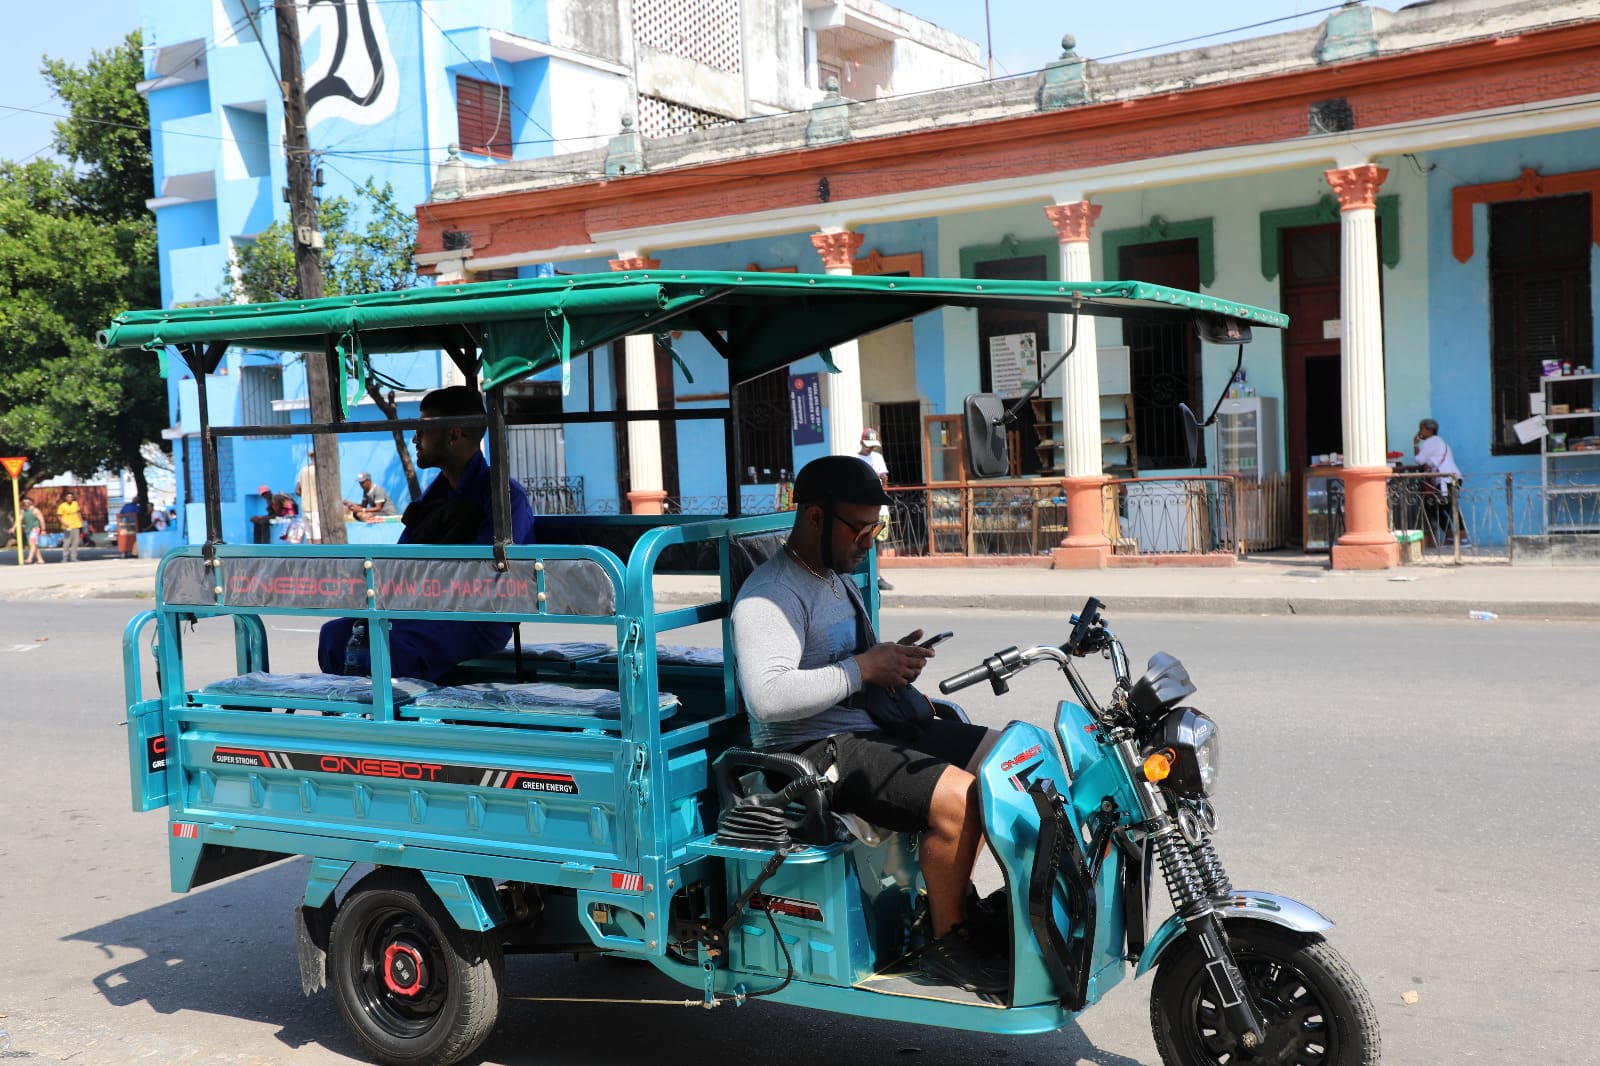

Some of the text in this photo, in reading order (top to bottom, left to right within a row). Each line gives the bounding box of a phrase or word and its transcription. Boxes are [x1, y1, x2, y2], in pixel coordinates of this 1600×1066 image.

[229, 575, 364, 596] ONEBOT
[152, 759, 166, 768] GRE
[216, 755, 258, 766] SUPER STRONG
[1001, 744, 1041, 771] ONEBOT
[320, 756, 442, 781] ONEBOT
[522, 781, 573, 793] GREEN ENERGY
